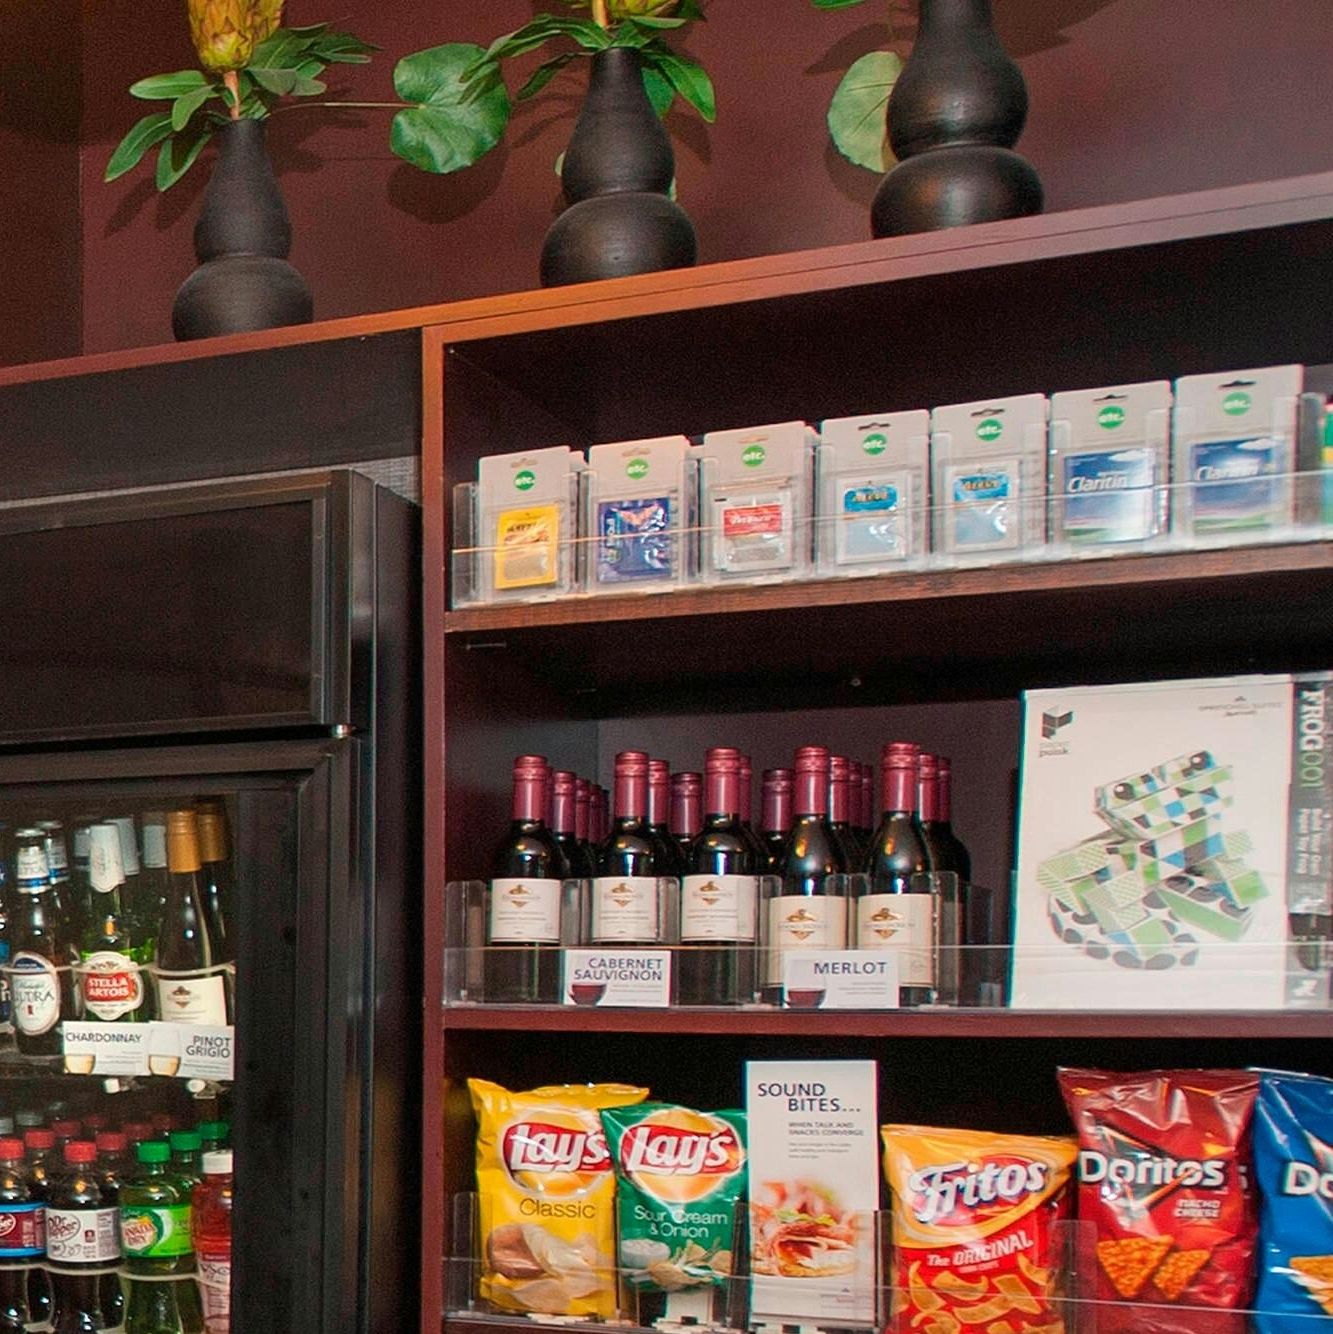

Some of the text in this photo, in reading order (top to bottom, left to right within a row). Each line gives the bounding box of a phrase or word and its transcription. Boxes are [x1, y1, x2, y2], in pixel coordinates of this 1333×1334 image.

[1067, 475, 1128, 493] Claritin
[588, 957, 663, 969] CABERNET
[814, 961, 887, 975] MERLOT
[573, 969, 663, 981] SAUVIGNON
[87, 978, 129, 988] STELLA
[88, 988, 130, 998] ARTOIS
[65, 1031, 142, 1043] CHARDONNAY
[193, 1036, 232, 1048] PINOT
[186, 1047, 231, 1058] GRIGIO
[757, 1083, 826, 1097] SOUND
[788, 1098, 861, 1112] BITES...
[509, 1123, 611, 1173] Lay's
[626, 1126, 733, 1176] Lay's
[1078, 1150, 1226, 1187] Doritos
[909, 1159, 1049, 1225] Fritos
[519, 1197, 596, 1219] Classic
[1176, 1199, 1221, 1208] NACHO
[634, 1203, 728, 1225] Sour Cream
[660, 1223, 709, 1238] Onion
[952, 1229, 1034, 1266] ORIGINAL
